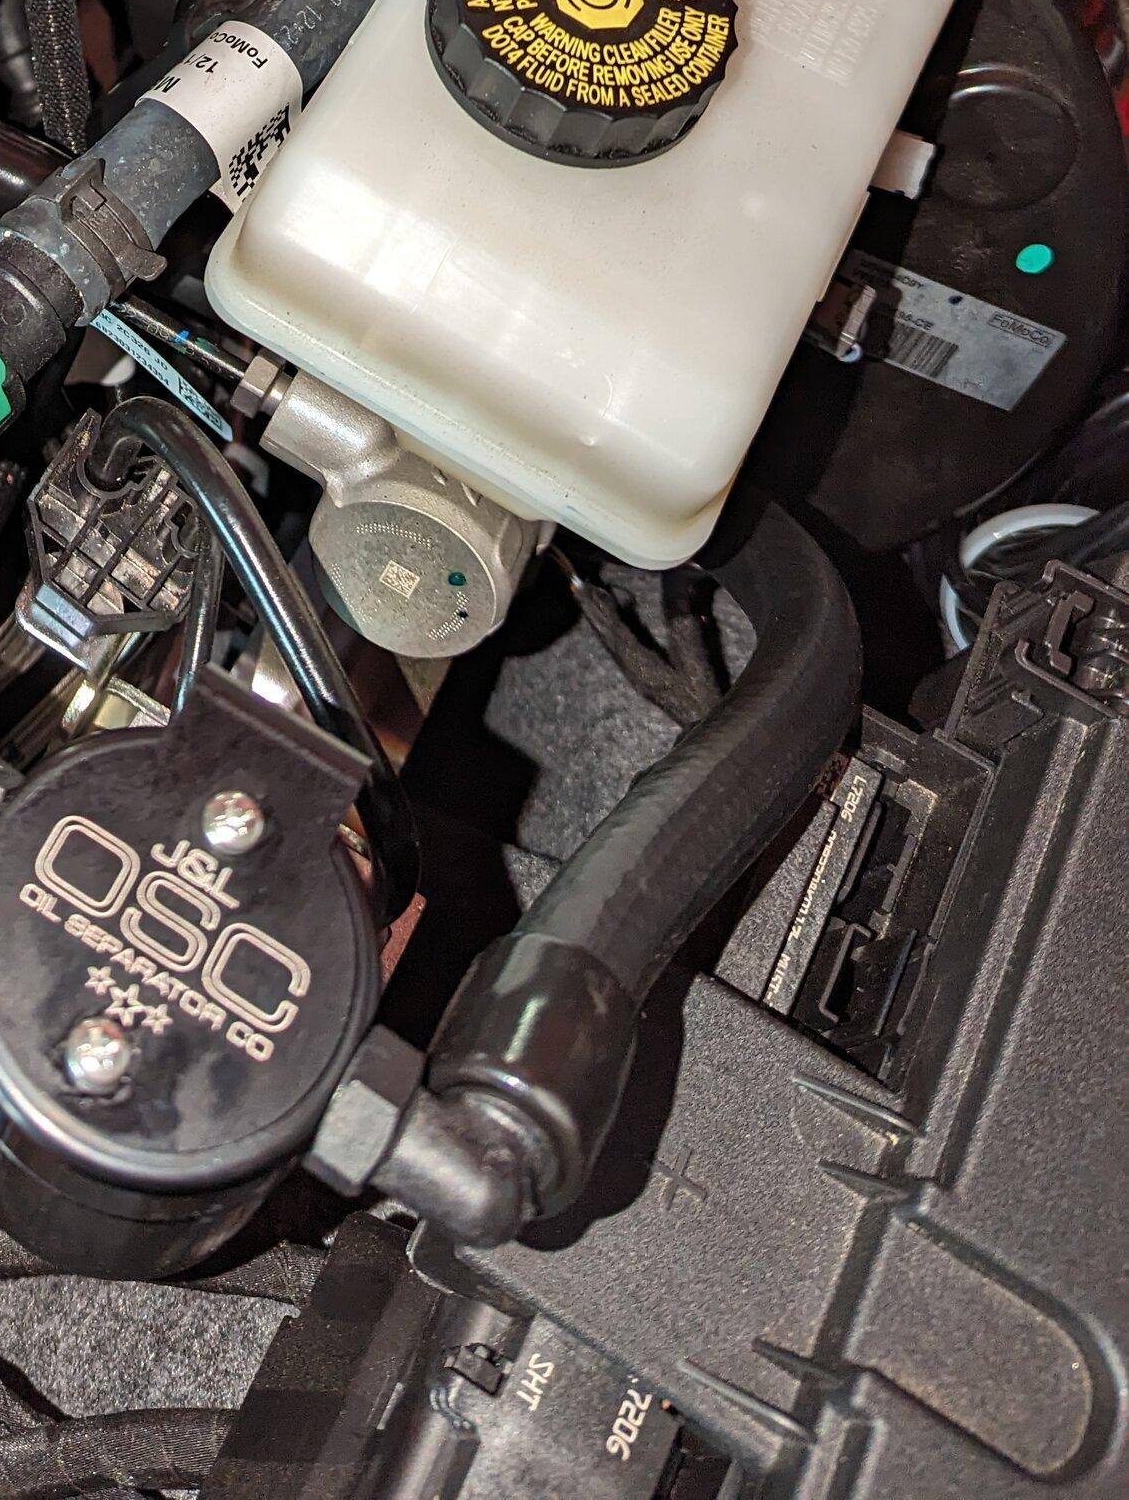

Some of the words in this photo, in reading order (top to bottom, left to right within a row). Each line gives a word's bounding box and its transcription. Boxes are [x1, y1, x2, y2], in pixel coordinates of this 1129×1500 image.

[504, 16, 535, 48] CAP
[530, 12, 602, 62] WARNING
[603, 37, 657, 65] CLEAN
[650, 6, 682, 52] FILLER
[680, 5, 706, 42] ONLY
[210, 32, 269, 70] FoMoCo
[482, 23, 522, 64] DOT4
[519, 56, 566, 92] FLUID
[566, 78, 614, 107] FROM
[619, 87, 631, 108] A
[631, 73, 689, 107] SEALED
[682, 14, 729, 85] CONTAINER
[527, 35, 590, 82] BEFORE
[592, 52, 674, 86] REMOVING
[669, 35, 697, 66] USE
[990, 312, 1054, 347] FoMoCo
[150, 840, 240, 909] J&L
[34, 815, 311, 1033] OSC
[19, 883, 62, 923] OIL
[63, 913, 228, 1031] SEPARATOR
[225, 1020, 275, 1063] CO
[516, 1352, 555, 1412] SHT
[605, 1375, 654, 1462] 7206
